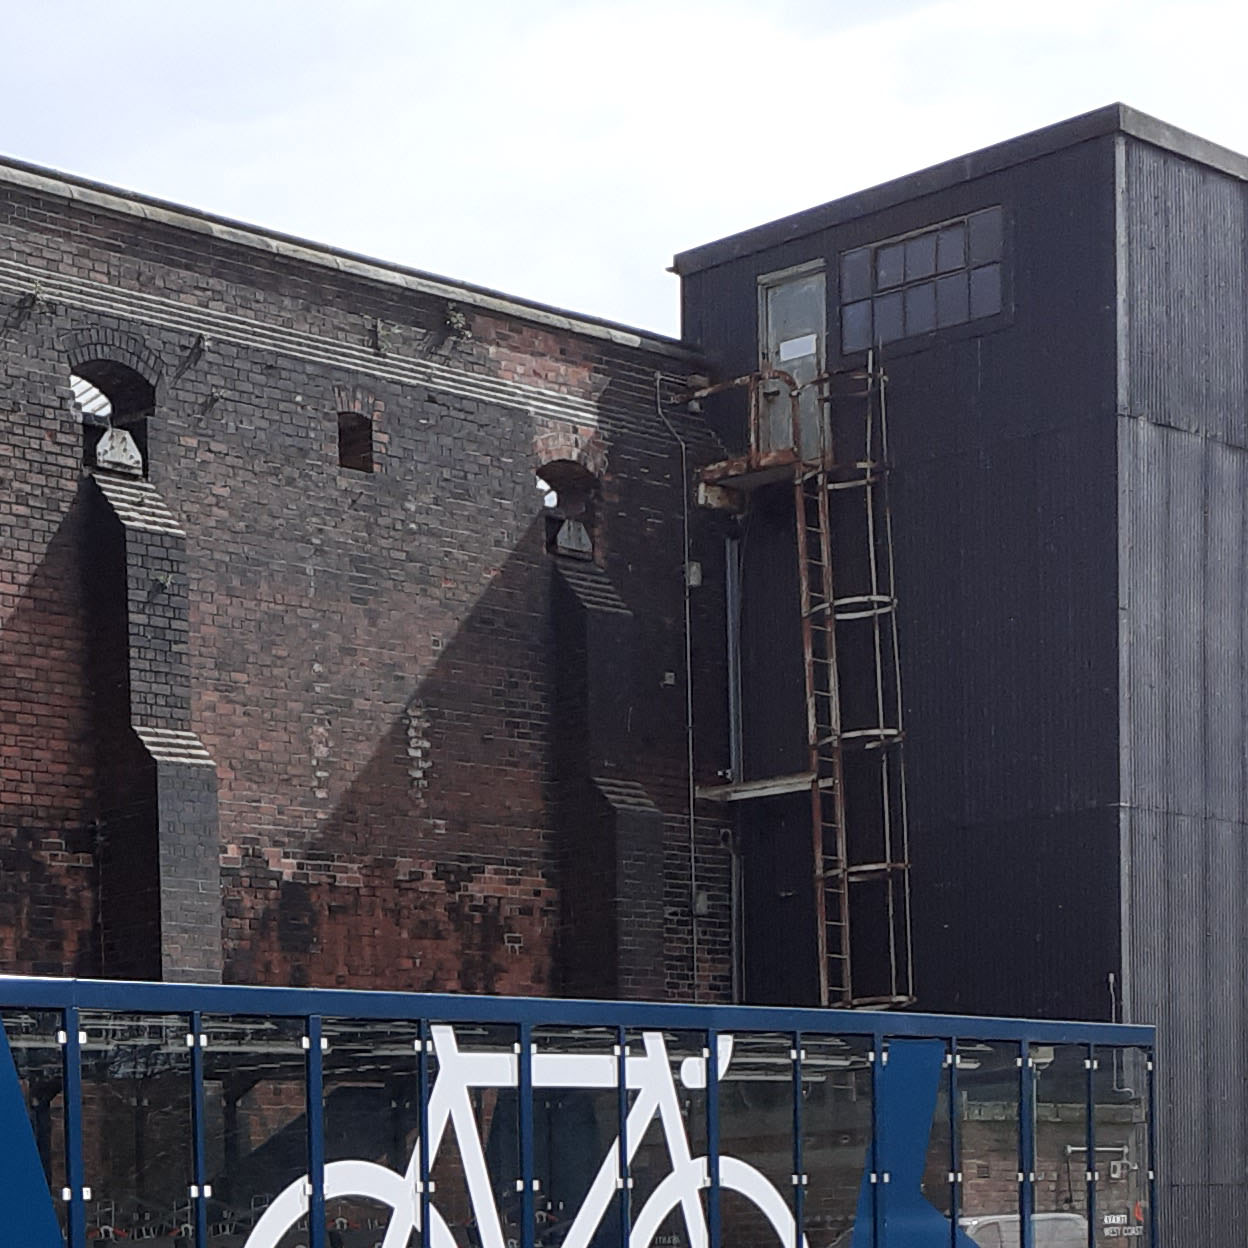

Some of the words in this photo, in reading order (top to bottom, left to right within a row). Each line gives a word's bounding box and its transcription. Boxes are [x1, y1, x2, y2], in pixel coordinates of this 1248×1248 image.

[1103, 1214, 1128, 1224] AVANTI
[1103, 1226, 1121, 1237] WEST
[1123, 1225, 1144, 1236] COAST
